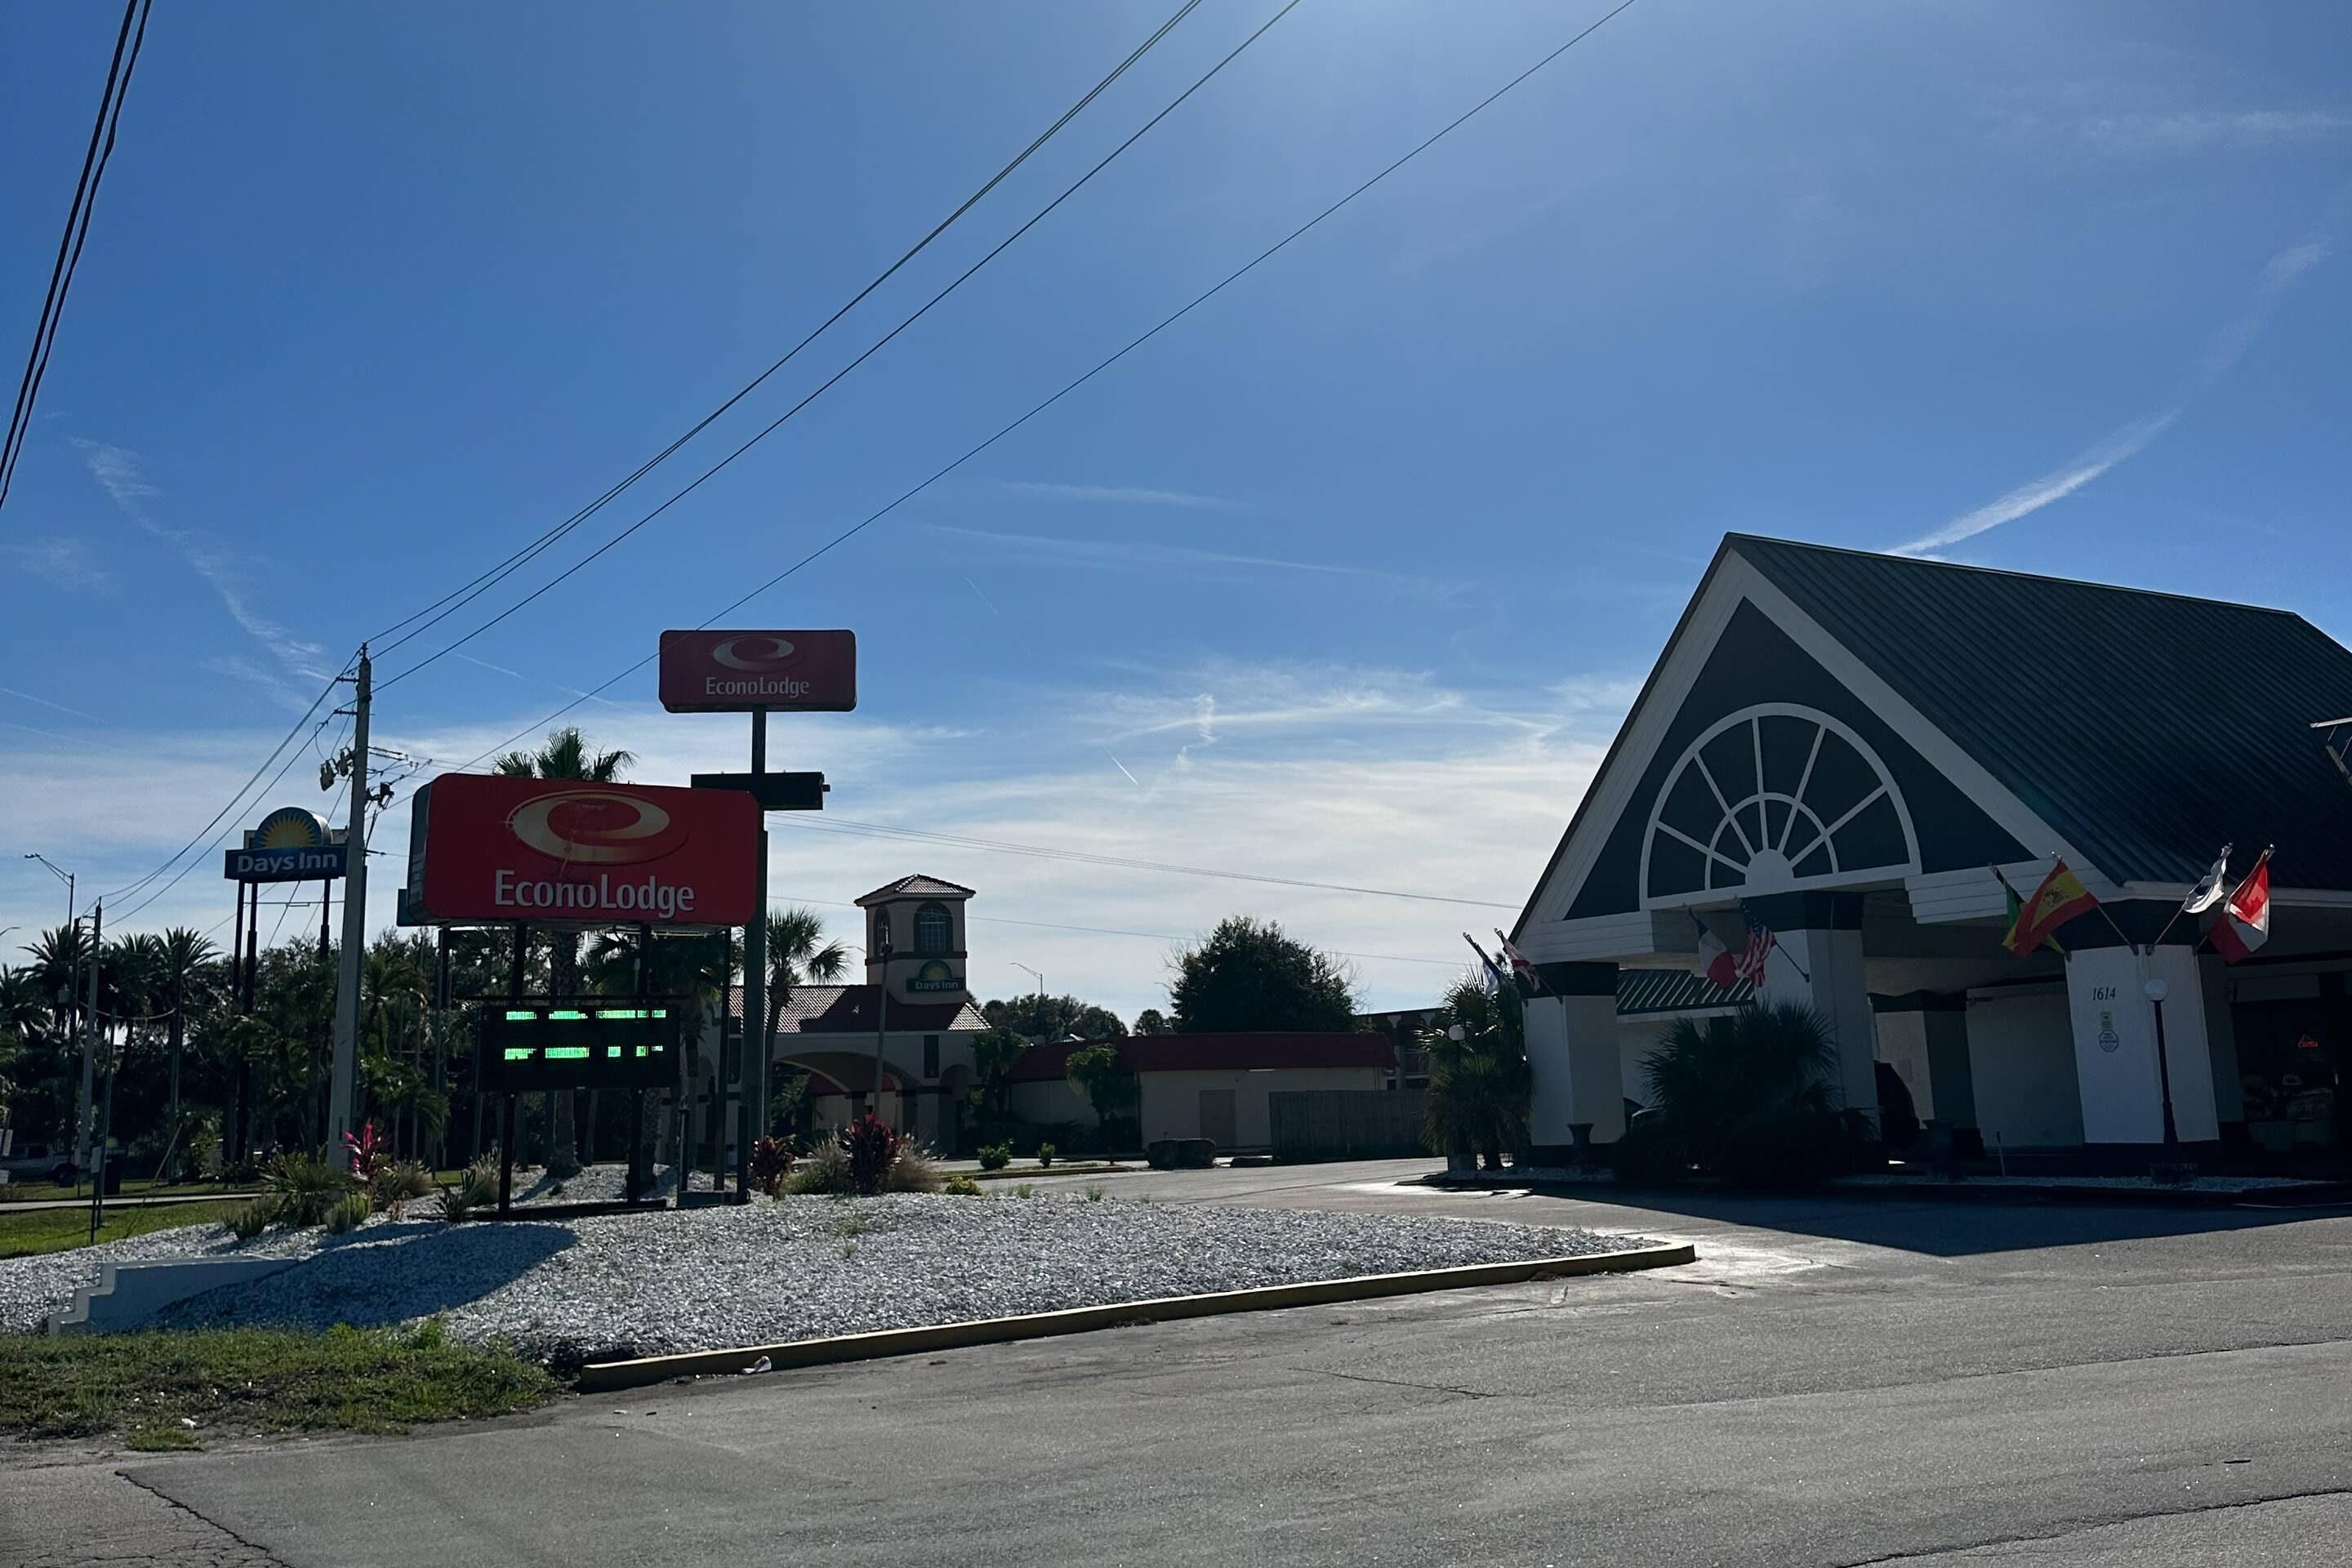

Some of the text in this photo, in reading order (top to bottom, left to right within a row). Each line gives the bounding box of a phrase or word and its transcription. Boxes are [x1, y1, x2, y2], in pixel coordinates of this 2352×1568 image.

[705, 676, 810, 698] EconoLodge
[237, 852, 337, 874] Days Inn
[494, 869, 695, 919] EconoLodge
[915, 981, 959, 990] Days Inn
[2092, 987, 2117, 1000] 1614
